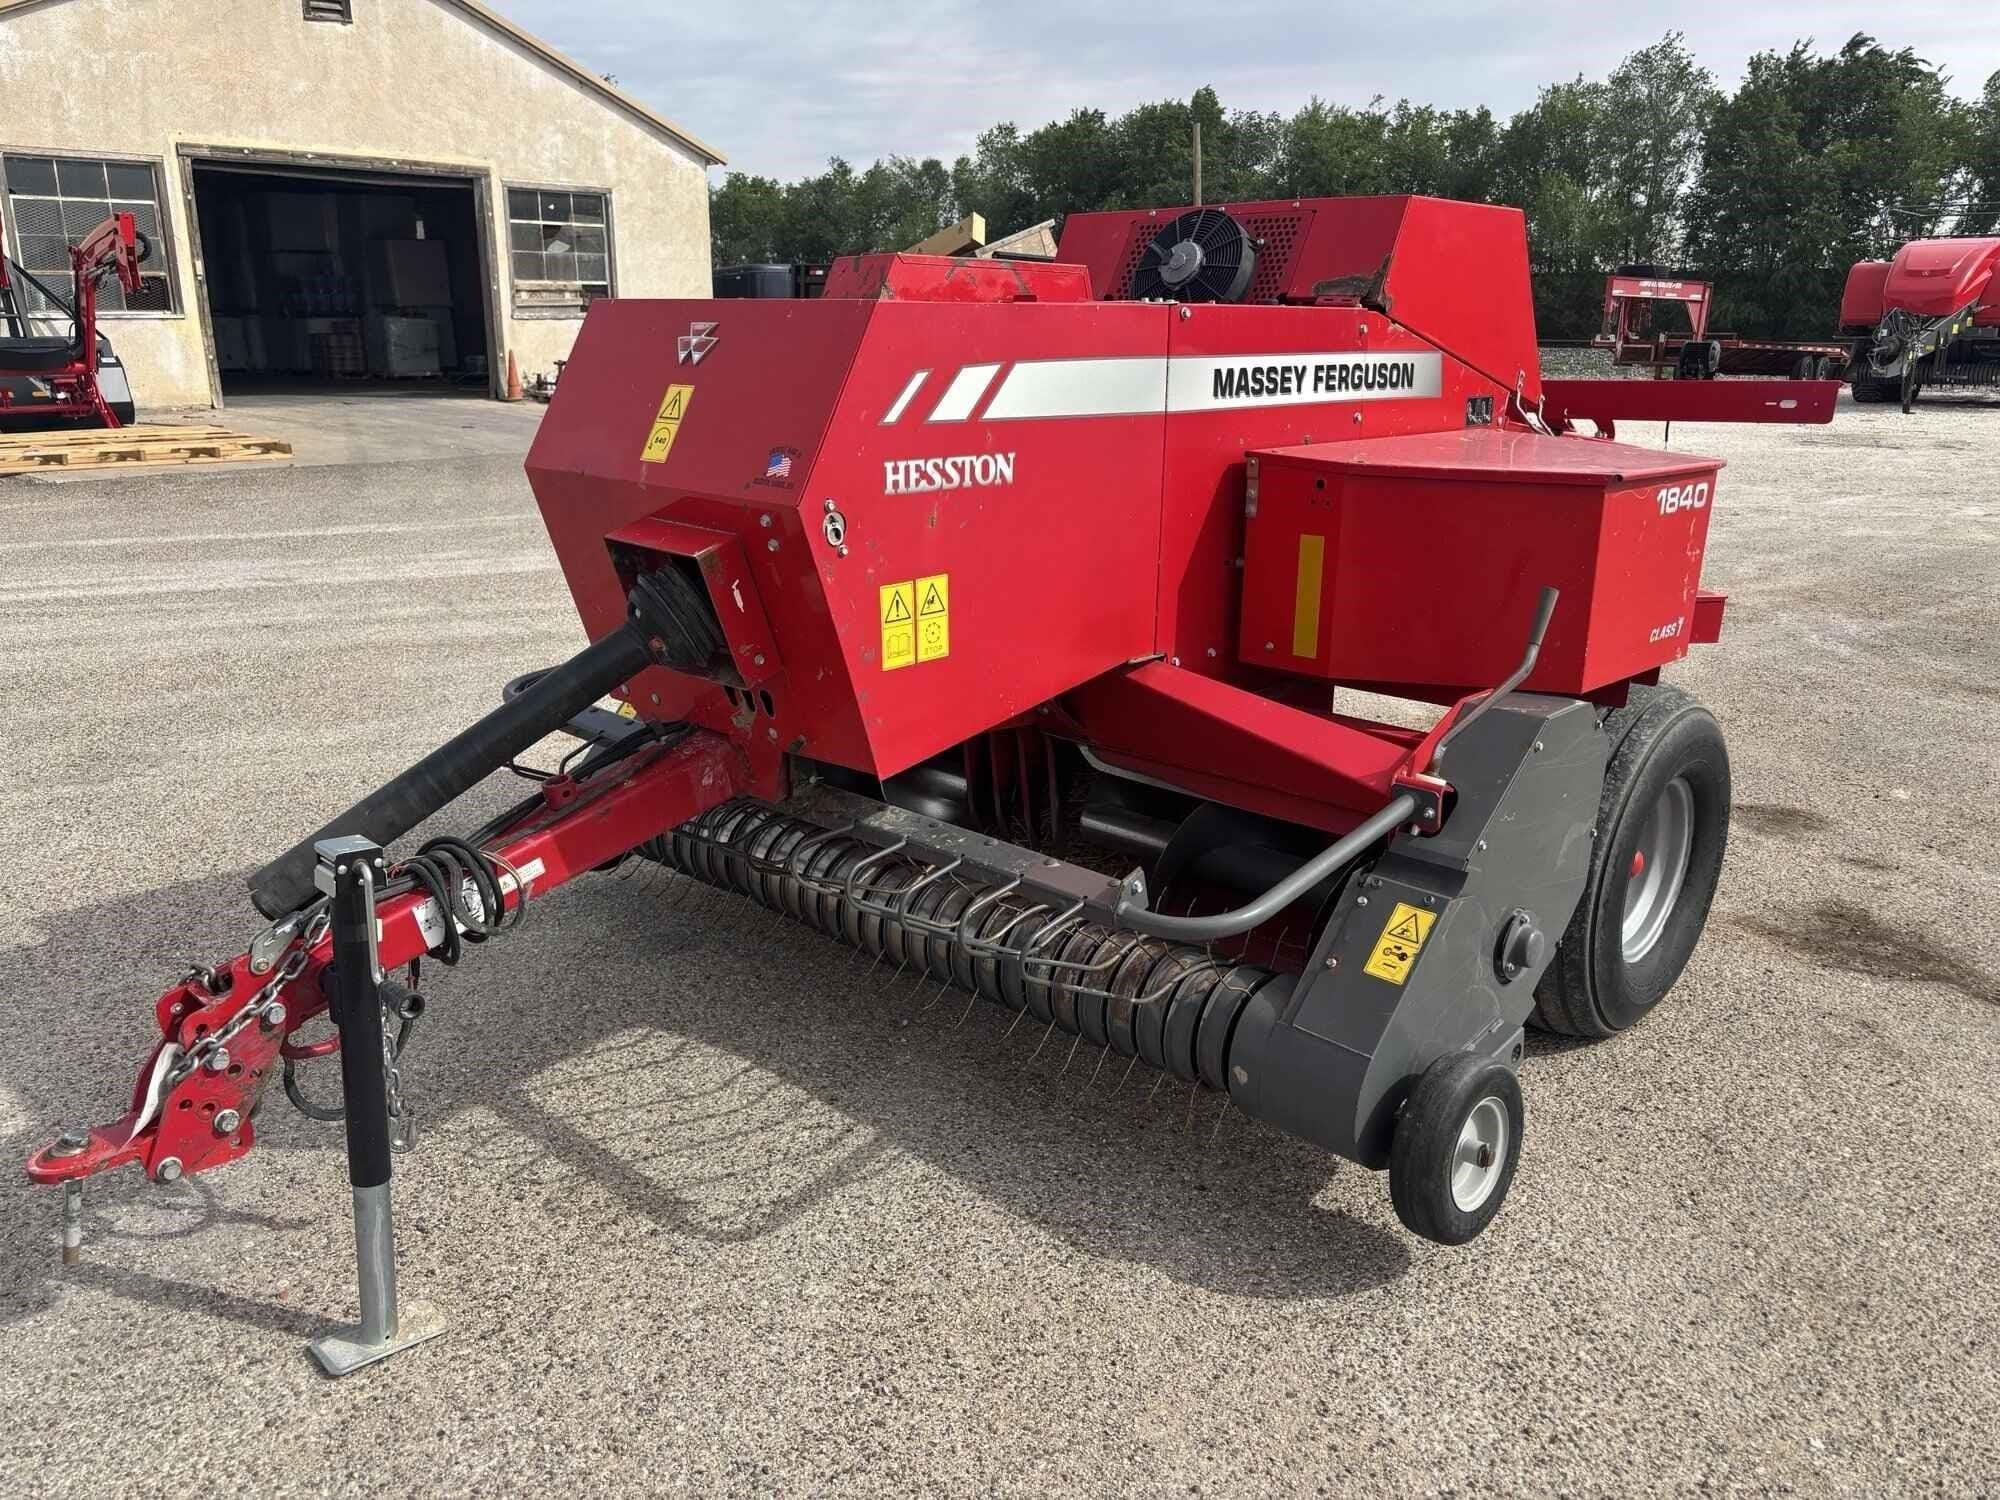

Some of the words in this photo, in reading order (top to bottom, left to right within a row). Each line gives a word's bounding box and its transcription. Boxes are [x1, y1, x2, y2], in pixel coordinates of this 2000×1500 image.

[1213, 366, 1307, 399] MASSEY
[1313, 363, 1415, 393] FERGUSON
[884, 452, 1016, 495] HESSTON
[1657, 483, 1708, 514] 1840
[1649, 622, 1677, 642] CLASS
